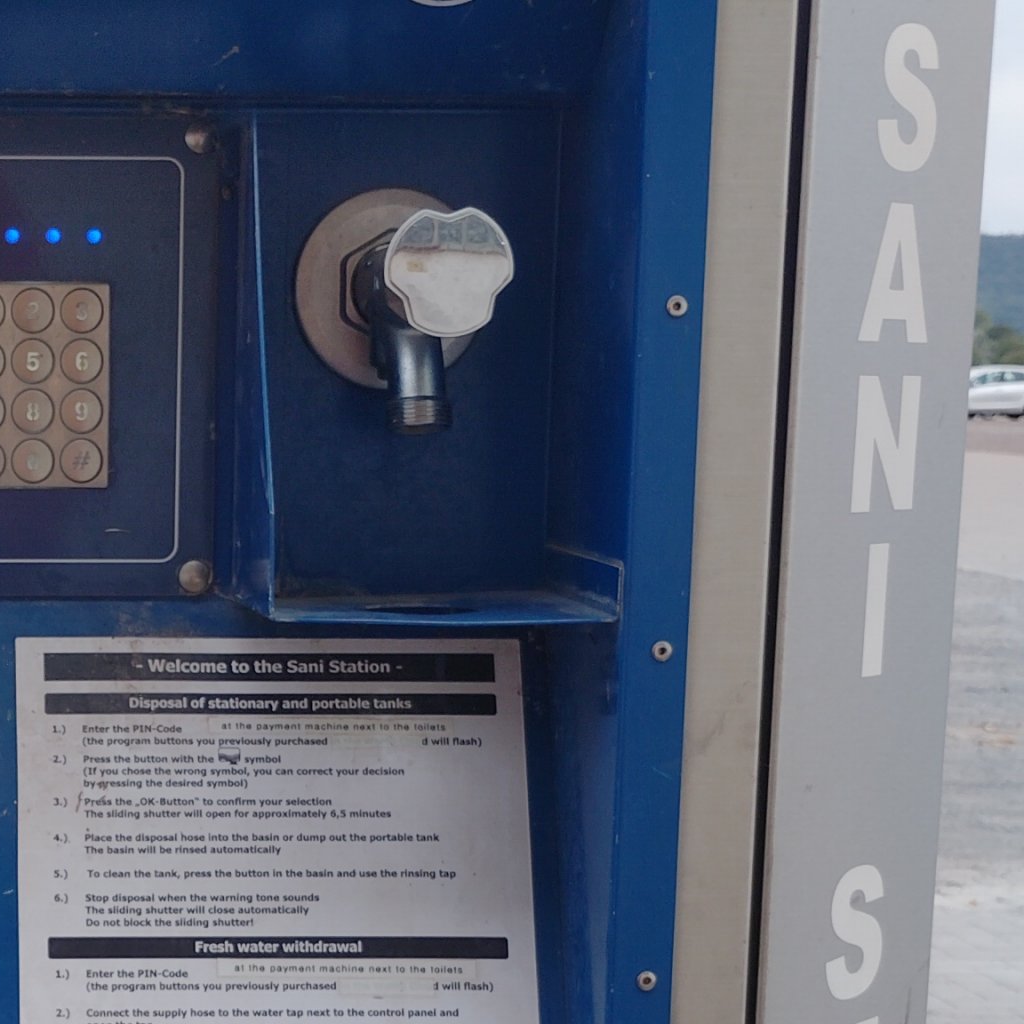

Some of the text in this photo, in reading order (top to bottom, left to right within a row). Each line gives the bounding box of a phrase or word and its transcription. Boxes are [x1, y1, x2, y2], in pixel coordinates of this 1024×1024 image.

[850, 22, 939, 678] SANI
[26, 351, 88, 371] 5 6
[26, 402, 40, 421] 8
[75, 402, 88, 421] 9
[147, 658, 390, 673] Welcome to the Sani Station
[129, 696, 411, 711] Disposal of stationary and portable tanks
[223, 721, 447, 733] at the payment machine next to the toilets
[85, 844, 281, 857] The basin will be rinsed automatically
[195, 940, 362, 954] Fresh water withdrawal
